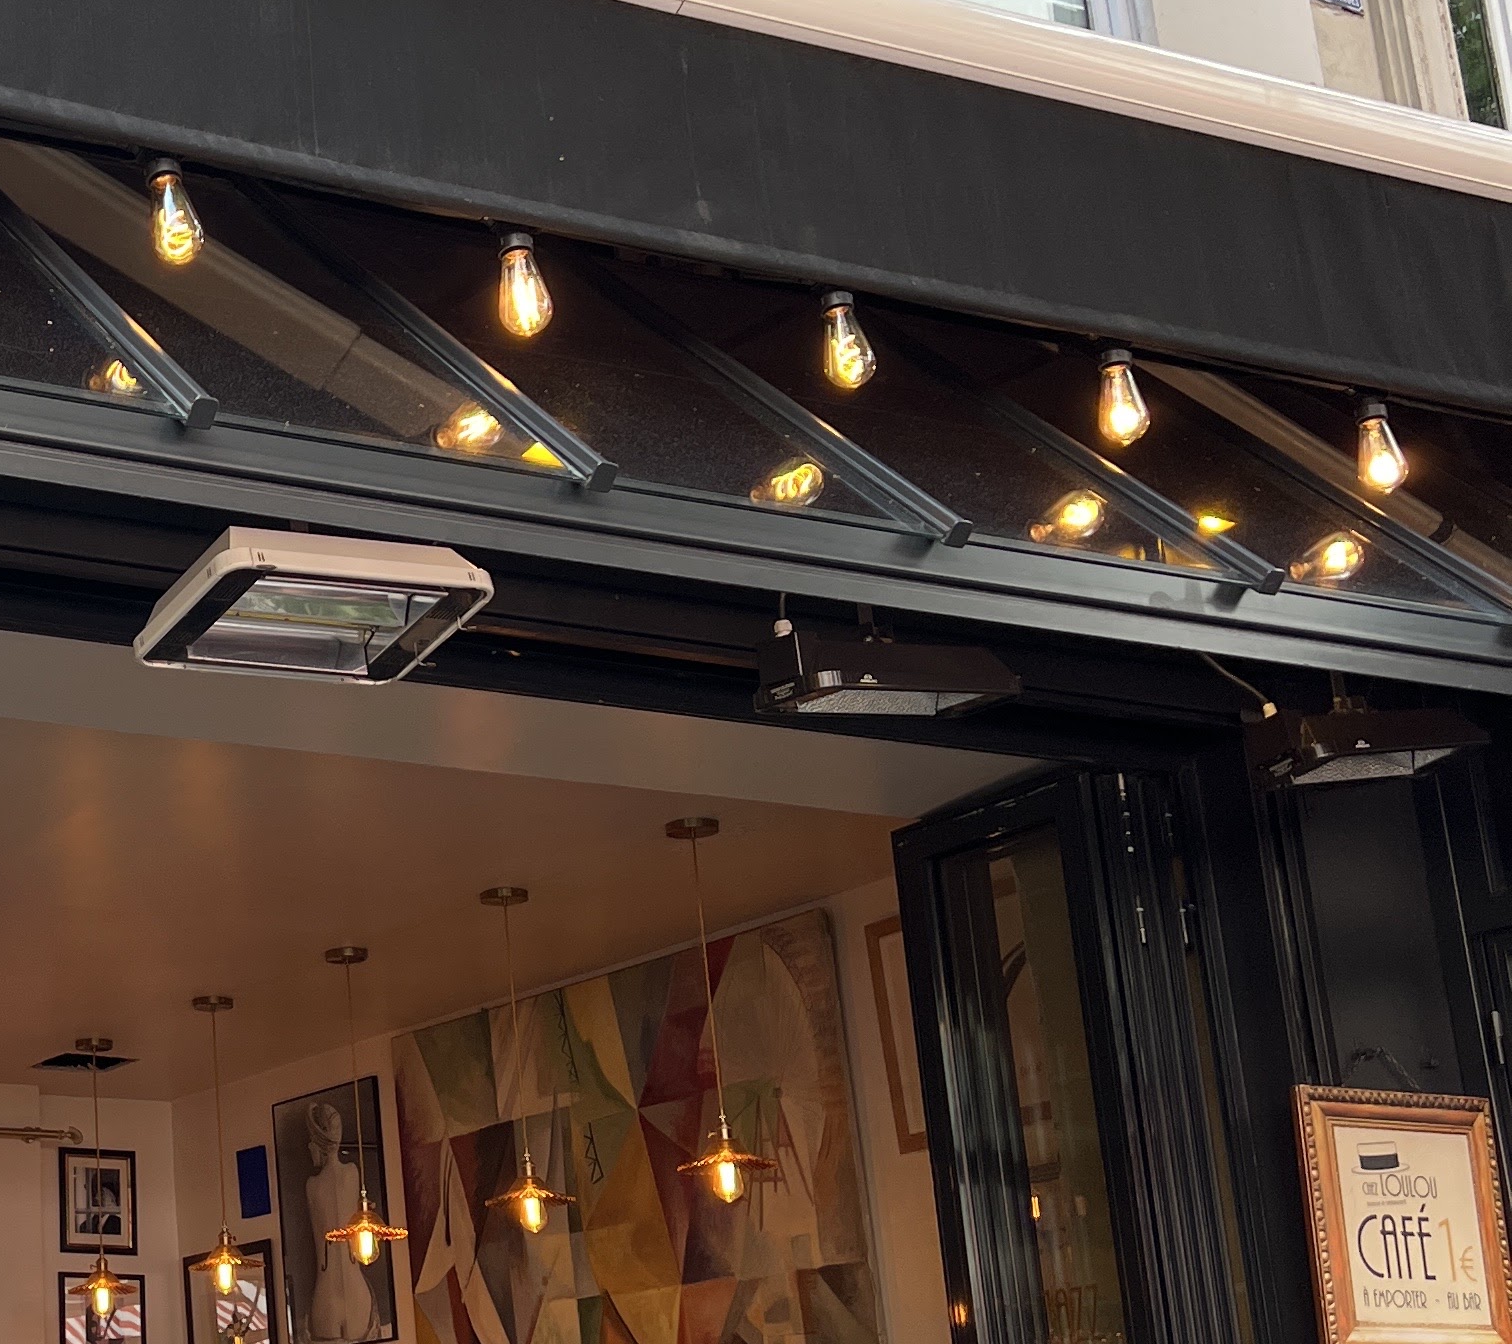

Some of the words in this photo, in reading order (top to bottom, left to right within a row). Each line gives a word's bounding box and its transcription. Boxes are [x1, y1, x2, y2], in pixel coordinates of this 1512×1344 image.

[1380, 1173, 1438, 1199] LOULOU
[1357, 1203, 1437, 1281] CAFÉ
[1374, 1289, 1428, 1310] EMPORTER
[1447, 1291, 1459, 1311] AU
[1463, 1292, 1482, 1311] BAR
